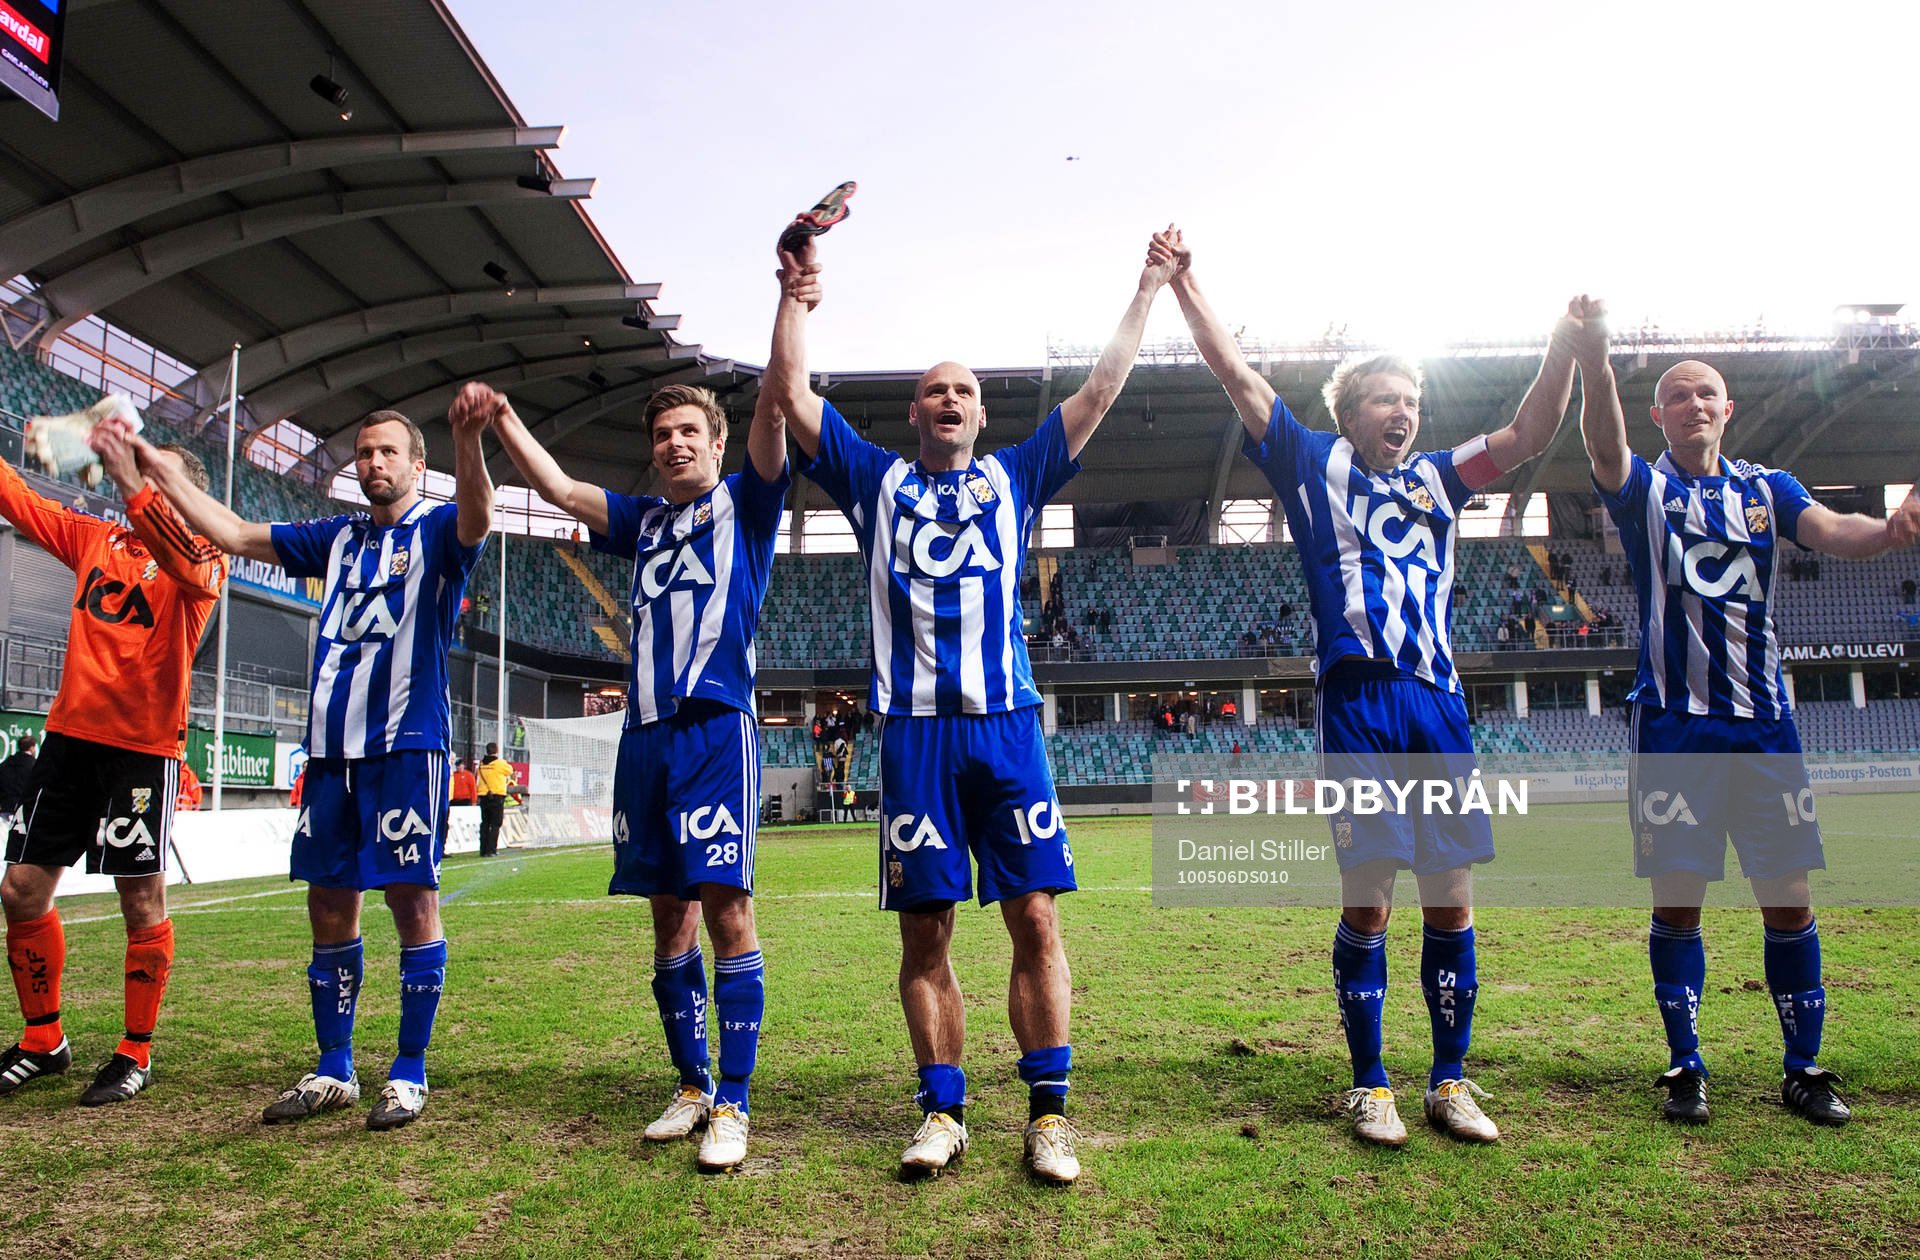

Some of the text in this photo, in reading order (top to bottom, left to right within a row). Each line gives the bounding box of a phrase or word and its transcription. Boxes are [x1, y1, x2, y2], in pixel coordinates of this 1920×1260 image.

[938, 484, 957, 496] ICA
[1703, 489, 1722, 501] ICA
[366, 539, 380, 550] ICA
[894, 516, 1002, 578] ICA
[1351, 495, 1443, 573] ICA
[1667, 541, 1764, 602] ICA
[73, 566, 154, 629] ICA
[321, 590, 399, 641] ICA
[1847, 643, 1905, 658] ULLEVI
[376, 806, 431, 843] ICA
[680, 803, 742, 844] ICA
[1637, 790, 1699, 825] ICA
[96, 817, 156, 848] ICA
[884, 813, 948, 851] ICA
[394, 844, 421, 866] 14
[706, 842, 738, 867] 28
[25, 949, 49, 994] SKF
[338, 967, 354, 1015] SKF
[691, 990, 706, 1040] SKF
[1438, 969, 1456, 1028] SKF
